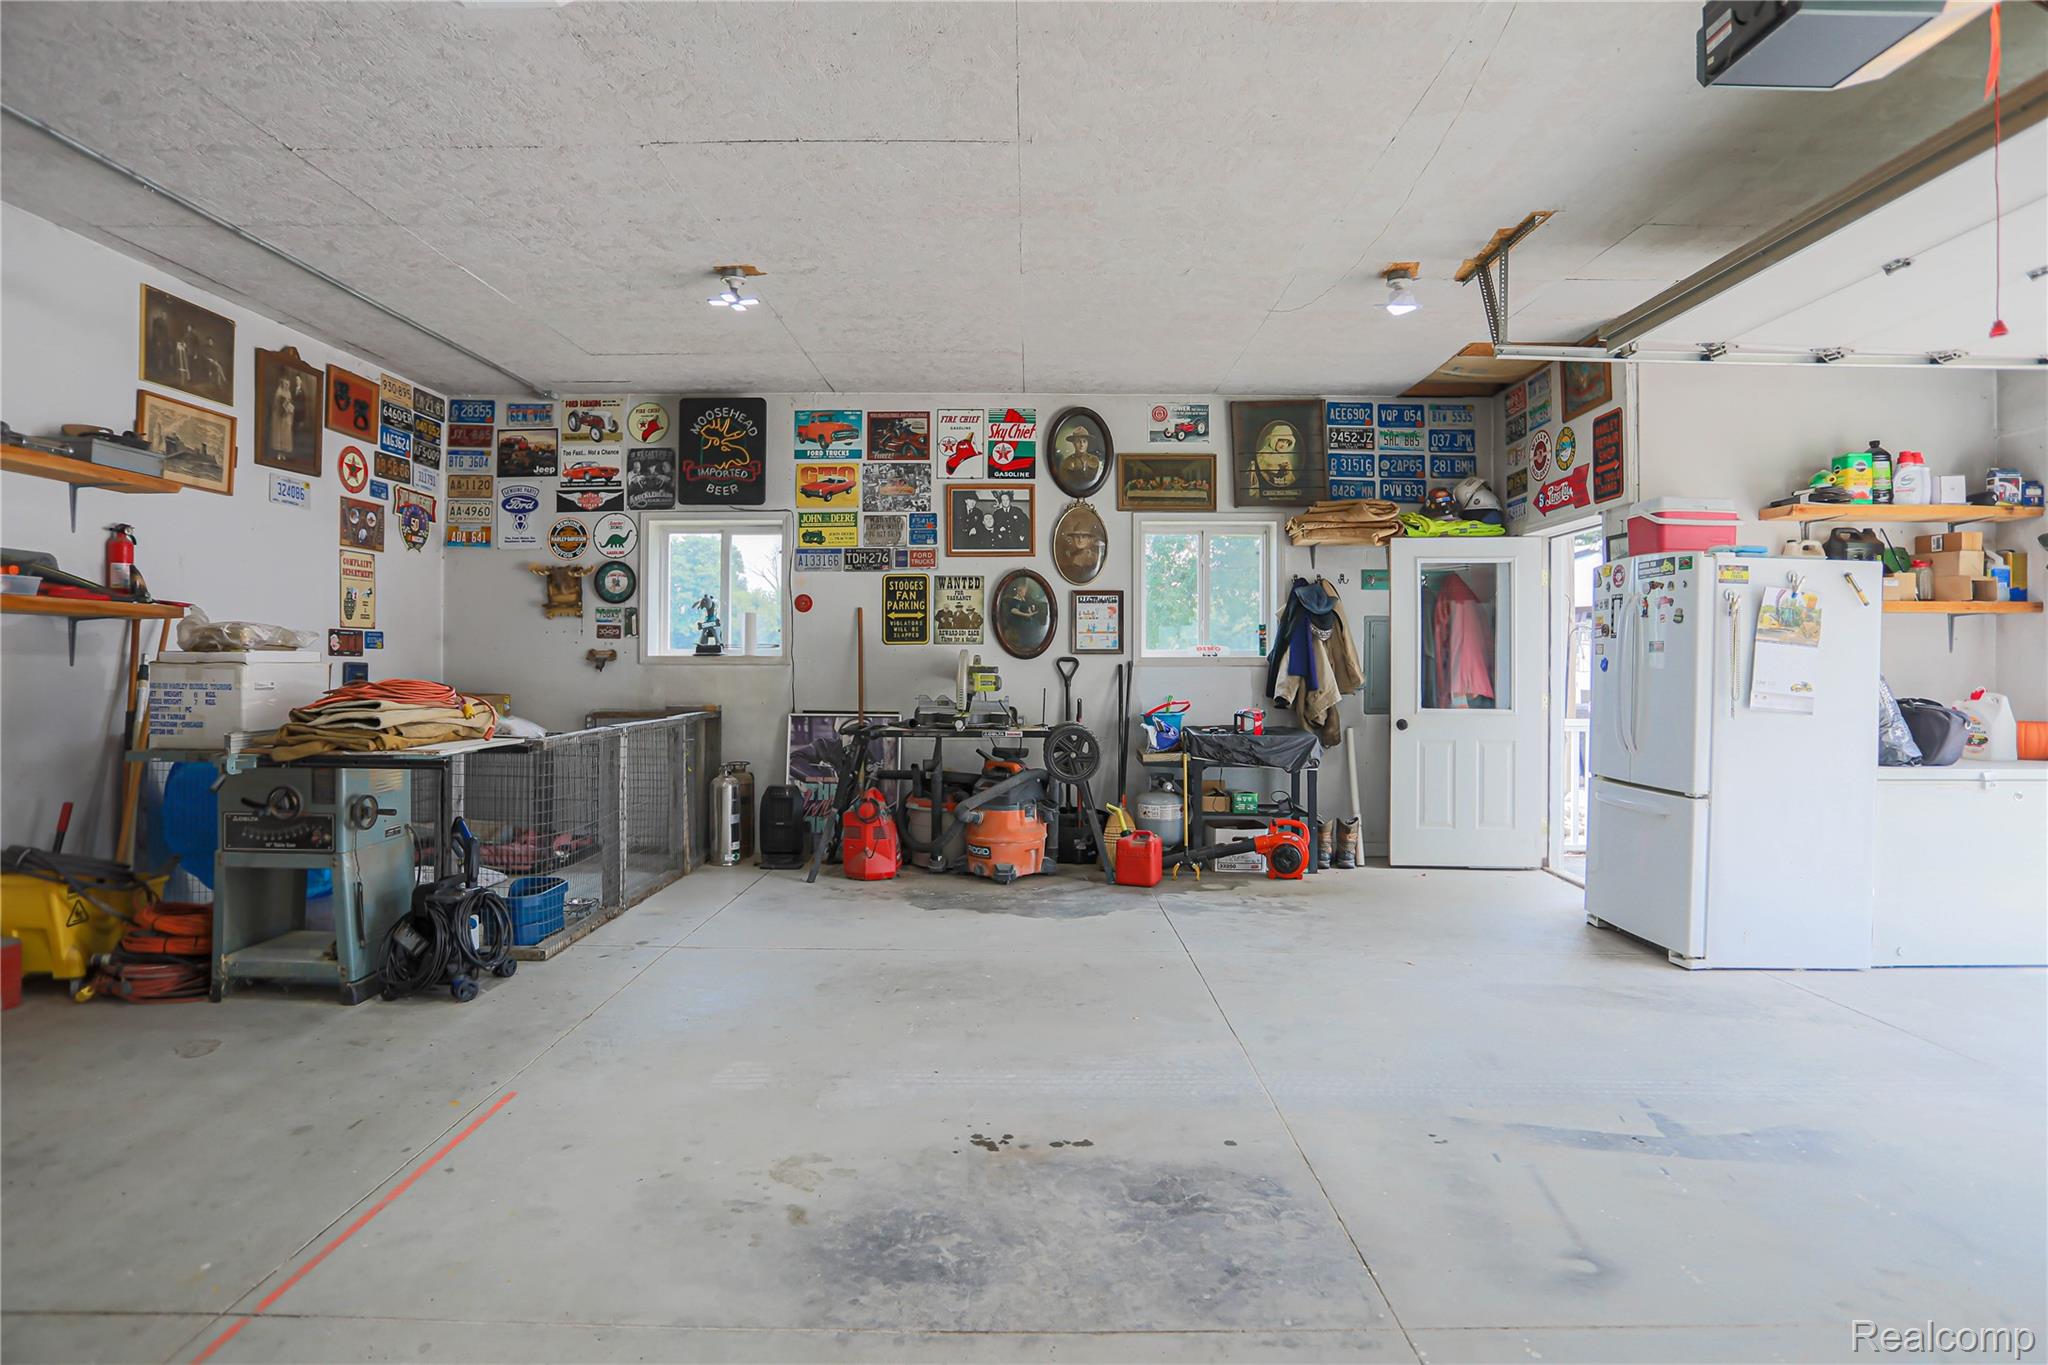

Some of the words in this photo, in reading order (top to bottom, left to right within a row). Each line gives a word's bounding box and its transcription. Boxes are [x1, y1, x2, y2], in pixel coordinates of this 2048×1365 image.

[460, 404, 493, 417] 28355
[1330, 408, 1371, 420] AEE6902
[1381, 410, 1399, 422] VQP
[690, 407, 758, 437] MOOSEHEAD
[941, 415, 957, 423] FIRE
[960, 415, 981, 423] CHIEF
[988, 424, 1008, 443] Sky
[1008, 423, 1036, 439] Chief
[1431, 433, 1450, 447] 037
[448, 456, 464, 468] BTG
[468, 456, 489, 468] 3604
[1340, 459, 1373, 472] 31516
[1433, 460, 1451, 473] 281
[533, 465, 555, 474] Jeep
[697, 467, 749, 479] IMPORTED
[800, 466, 855, 483] GTO
[503, 487, 523, 497] GENUINE
[523, 487, 538, 496] PARTS
[706, 483, 740, 496] BEER
[1405, 484, 1424, 497] 933
[505, 497, 534, 510] Ford
[801, 513, 822, 523] JOHN
[831, 513, 855, 523] DEERE
[552, 545, 573, 558] MOTOR
[343, 557, 372, 568] COMPLAINT
[798, 554, 840, 566] A133166
[889, 581, 924, 590] STOOGES
[938, 577, 981, 589] WANTED
[896, 591, 917, 600] FAN
[887, 601, 925, 610] PARKING
